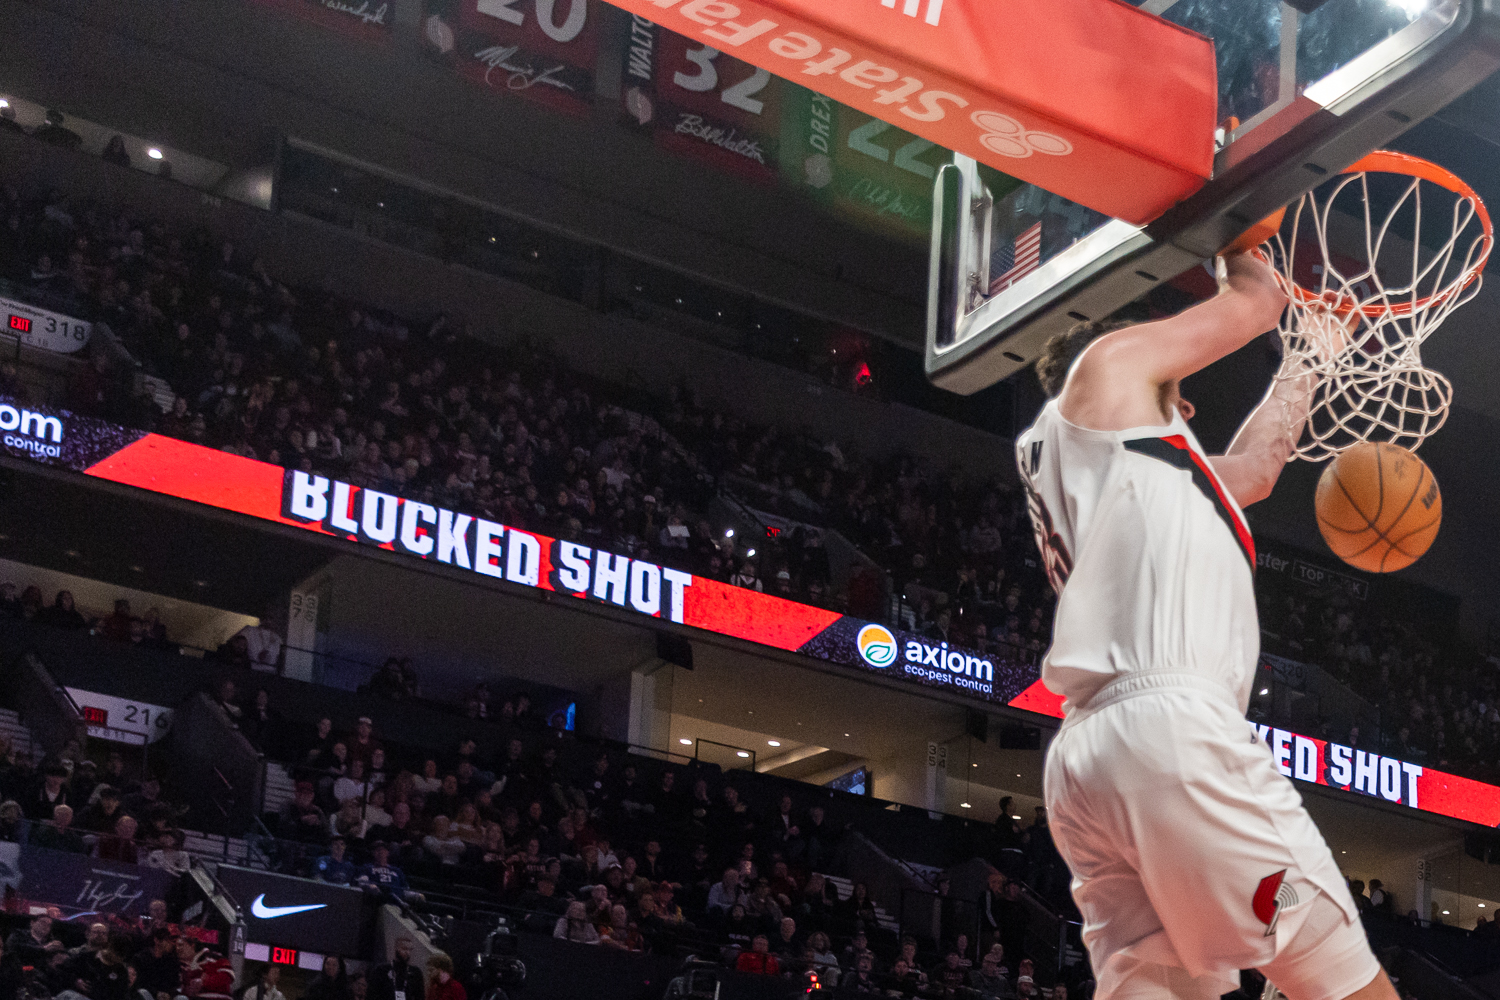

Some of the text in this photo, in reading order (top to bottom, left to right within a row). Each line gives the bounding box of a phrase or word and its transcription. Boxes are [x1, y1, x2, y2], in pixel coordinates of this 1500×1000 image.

[10, 318, 31, 332] EXIT
[45, 317, 85, 341] 318
[3, 434, 61, 458] control
[291, 470, 693, 625] BLOCKED SHOT
[904, 641, 994, 682] axiom
[904, 663, 993, 695] eco-pest control
[123, 705, 169, 730] 216
[1330, 742, 1423, 809] SHOT
[273, 946, 297, 965] EXIT
